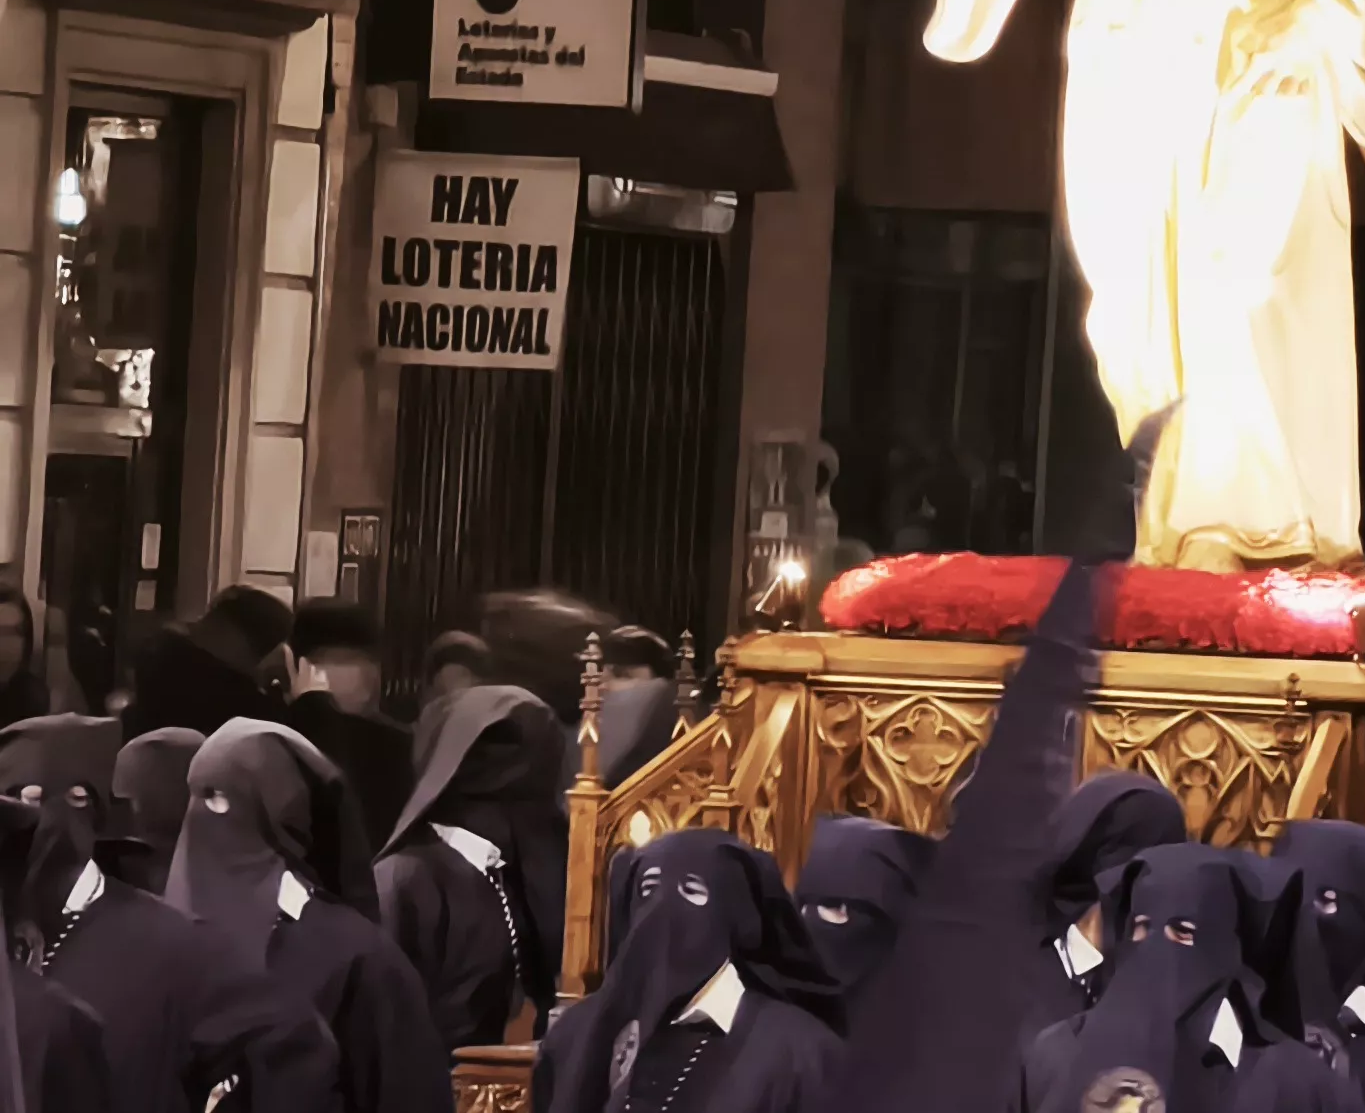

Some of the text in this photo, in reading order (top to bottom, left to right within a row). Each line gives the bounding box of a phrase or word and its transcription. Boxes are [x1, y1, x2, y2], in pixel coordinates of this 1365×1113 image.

[431, 174, 519, 226] HAY
[381, 235, 557, 293] LOTERIA
[378, 299, 550, 355] NACIONAL
